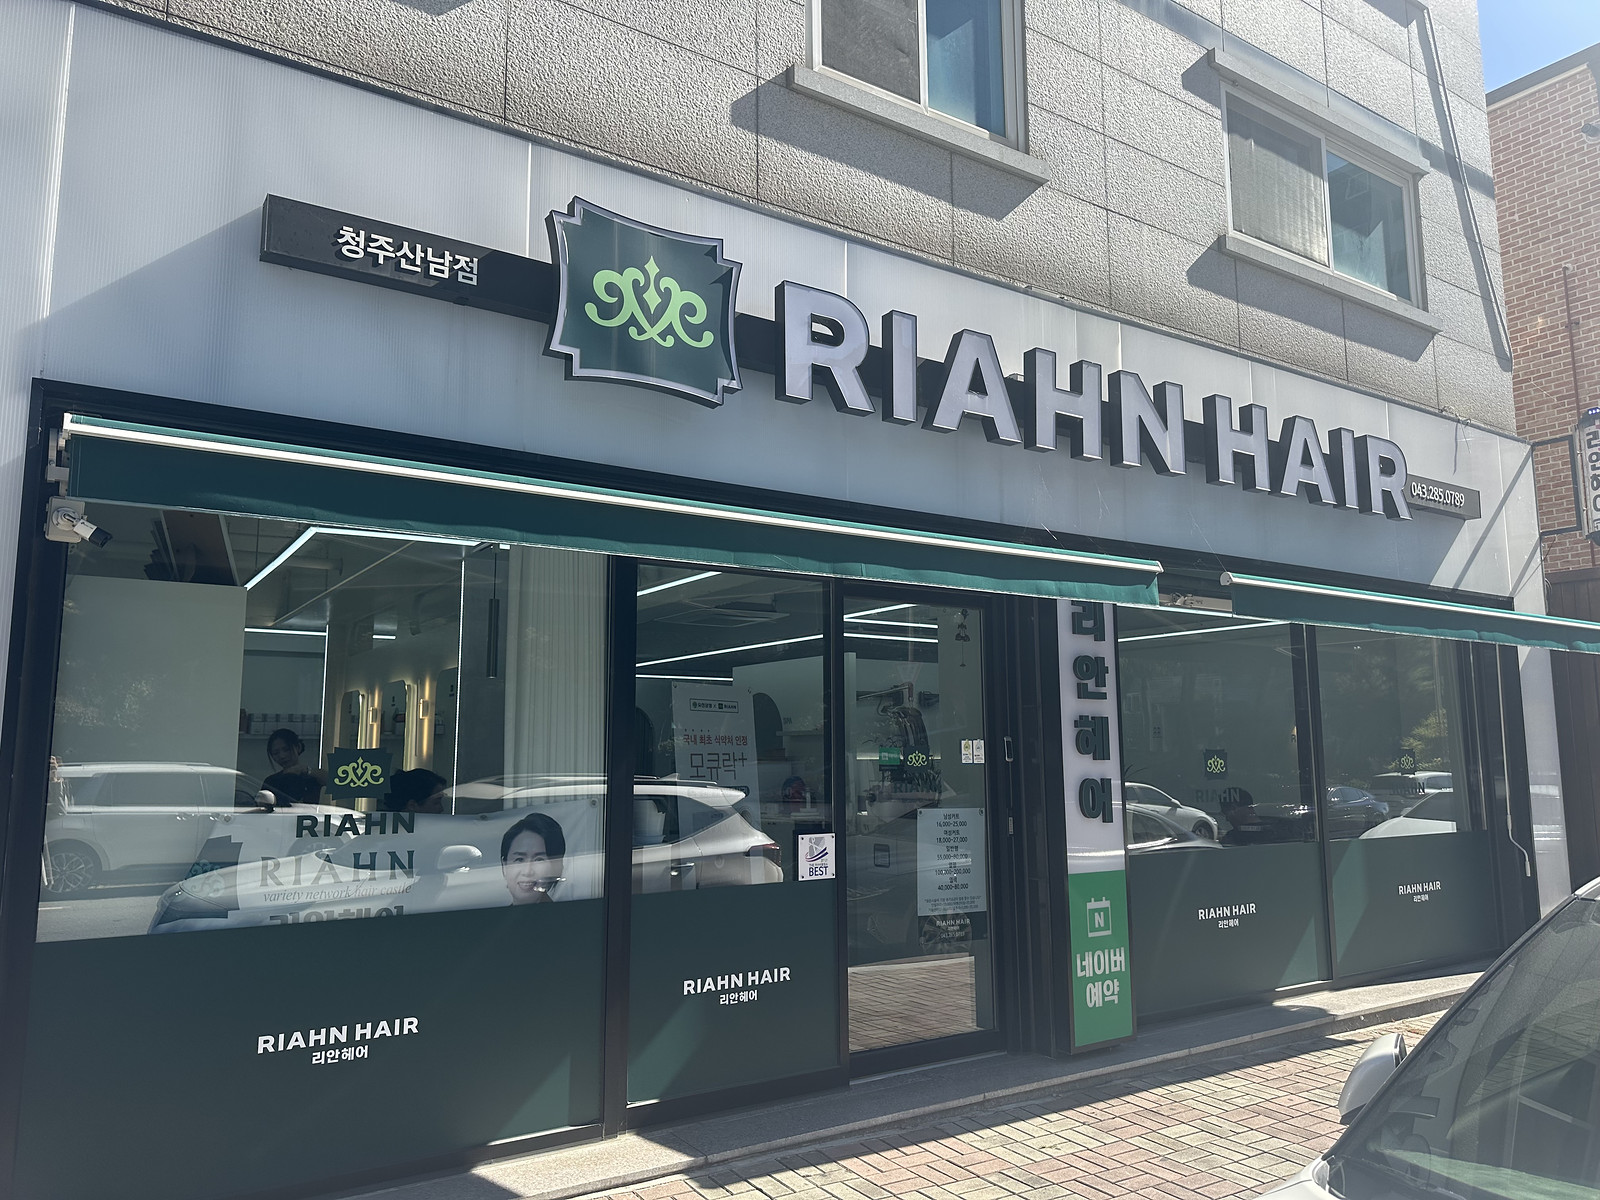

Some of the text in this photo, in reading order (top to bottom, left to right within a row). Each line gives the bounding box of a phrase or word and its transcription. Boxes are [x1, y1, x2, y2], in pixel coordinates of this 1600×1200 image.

[335, 225, 480, 286] 청주산남점
[775, 280, 1187, 476] RIAHN
[1203, 393, 1414, 521] HAIR
[1411, 480, 1466, 509] 043.285.0789
[1070, 602, 1114, 825] 리안헤어
[699, 734, 713, 746] 최초
[735, 735, 748, 746] 인정
[1195, 787, 1241, 804] RIAHN
[295, 812, 415, 838] RIAHN
[259, 850, 415, 887] RIAHN
[808, 866, 829, 877] BEST
[263, 880, 412, 904] variety network hair castle
[1398, 881, 1442, 896] RIAHN HAIR
[1197, 902, 1257, 921] RIAHN HAIR
[1218, 918, 1240, 929] 리안헤어
[1075, 946, 1126, 980] 네이버
[683, 967, 791, 996] RIAHN HAIR
[1085, 980, 1120, 1009] 예약
[719, 989, 758, 1006] 리안헤어
[257, 1017, 420, 1054] RIAHN HAIR
[311, 1045, 369, 1064] 리안헤어
